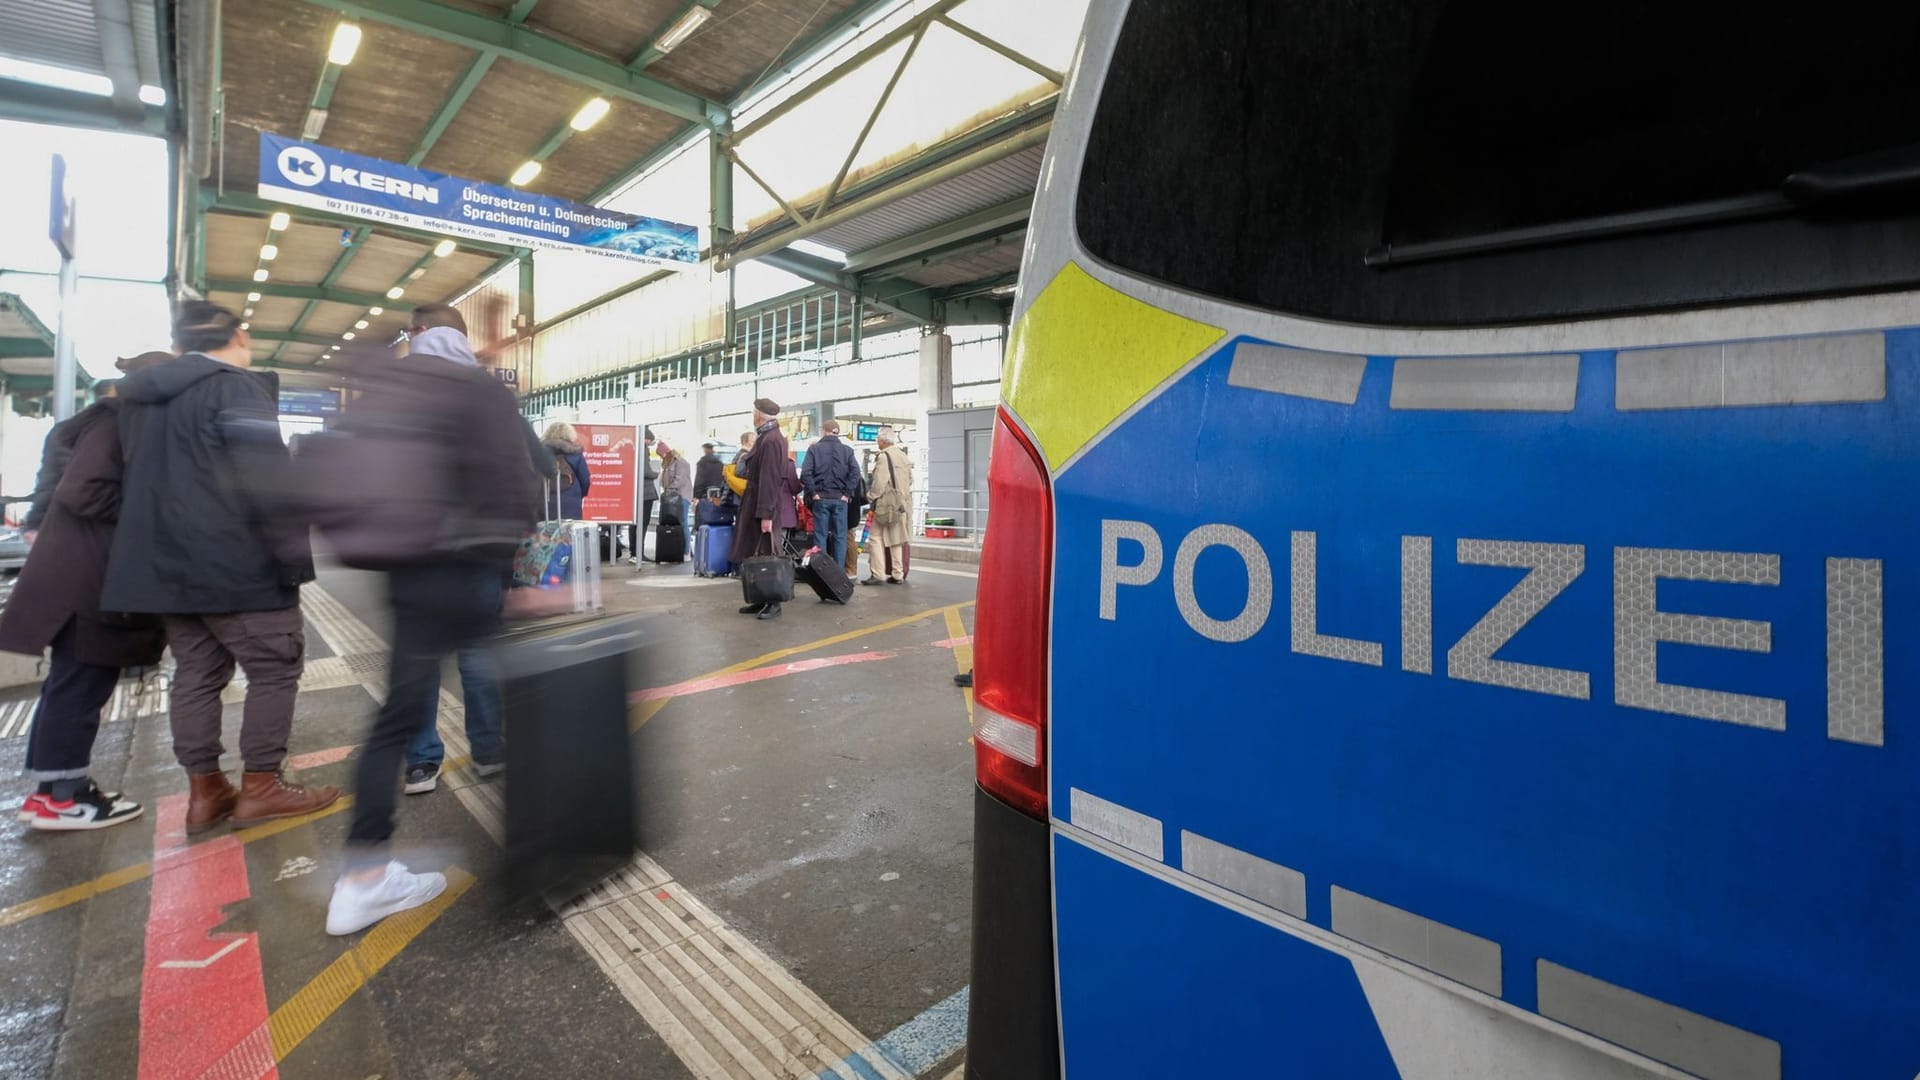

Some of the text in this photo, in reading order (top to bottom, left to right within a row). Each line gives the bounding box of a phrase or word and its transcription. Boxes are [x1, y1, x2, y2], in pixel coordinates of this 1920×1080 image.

[288, 156, 439, 204] K KERN
[462, 187, 628, 231] Übersetzen u. Dolmetschen
[462, 204, 570, 238] Sprachentraining
[1099, 519, 1884, 747] POLIZEI
